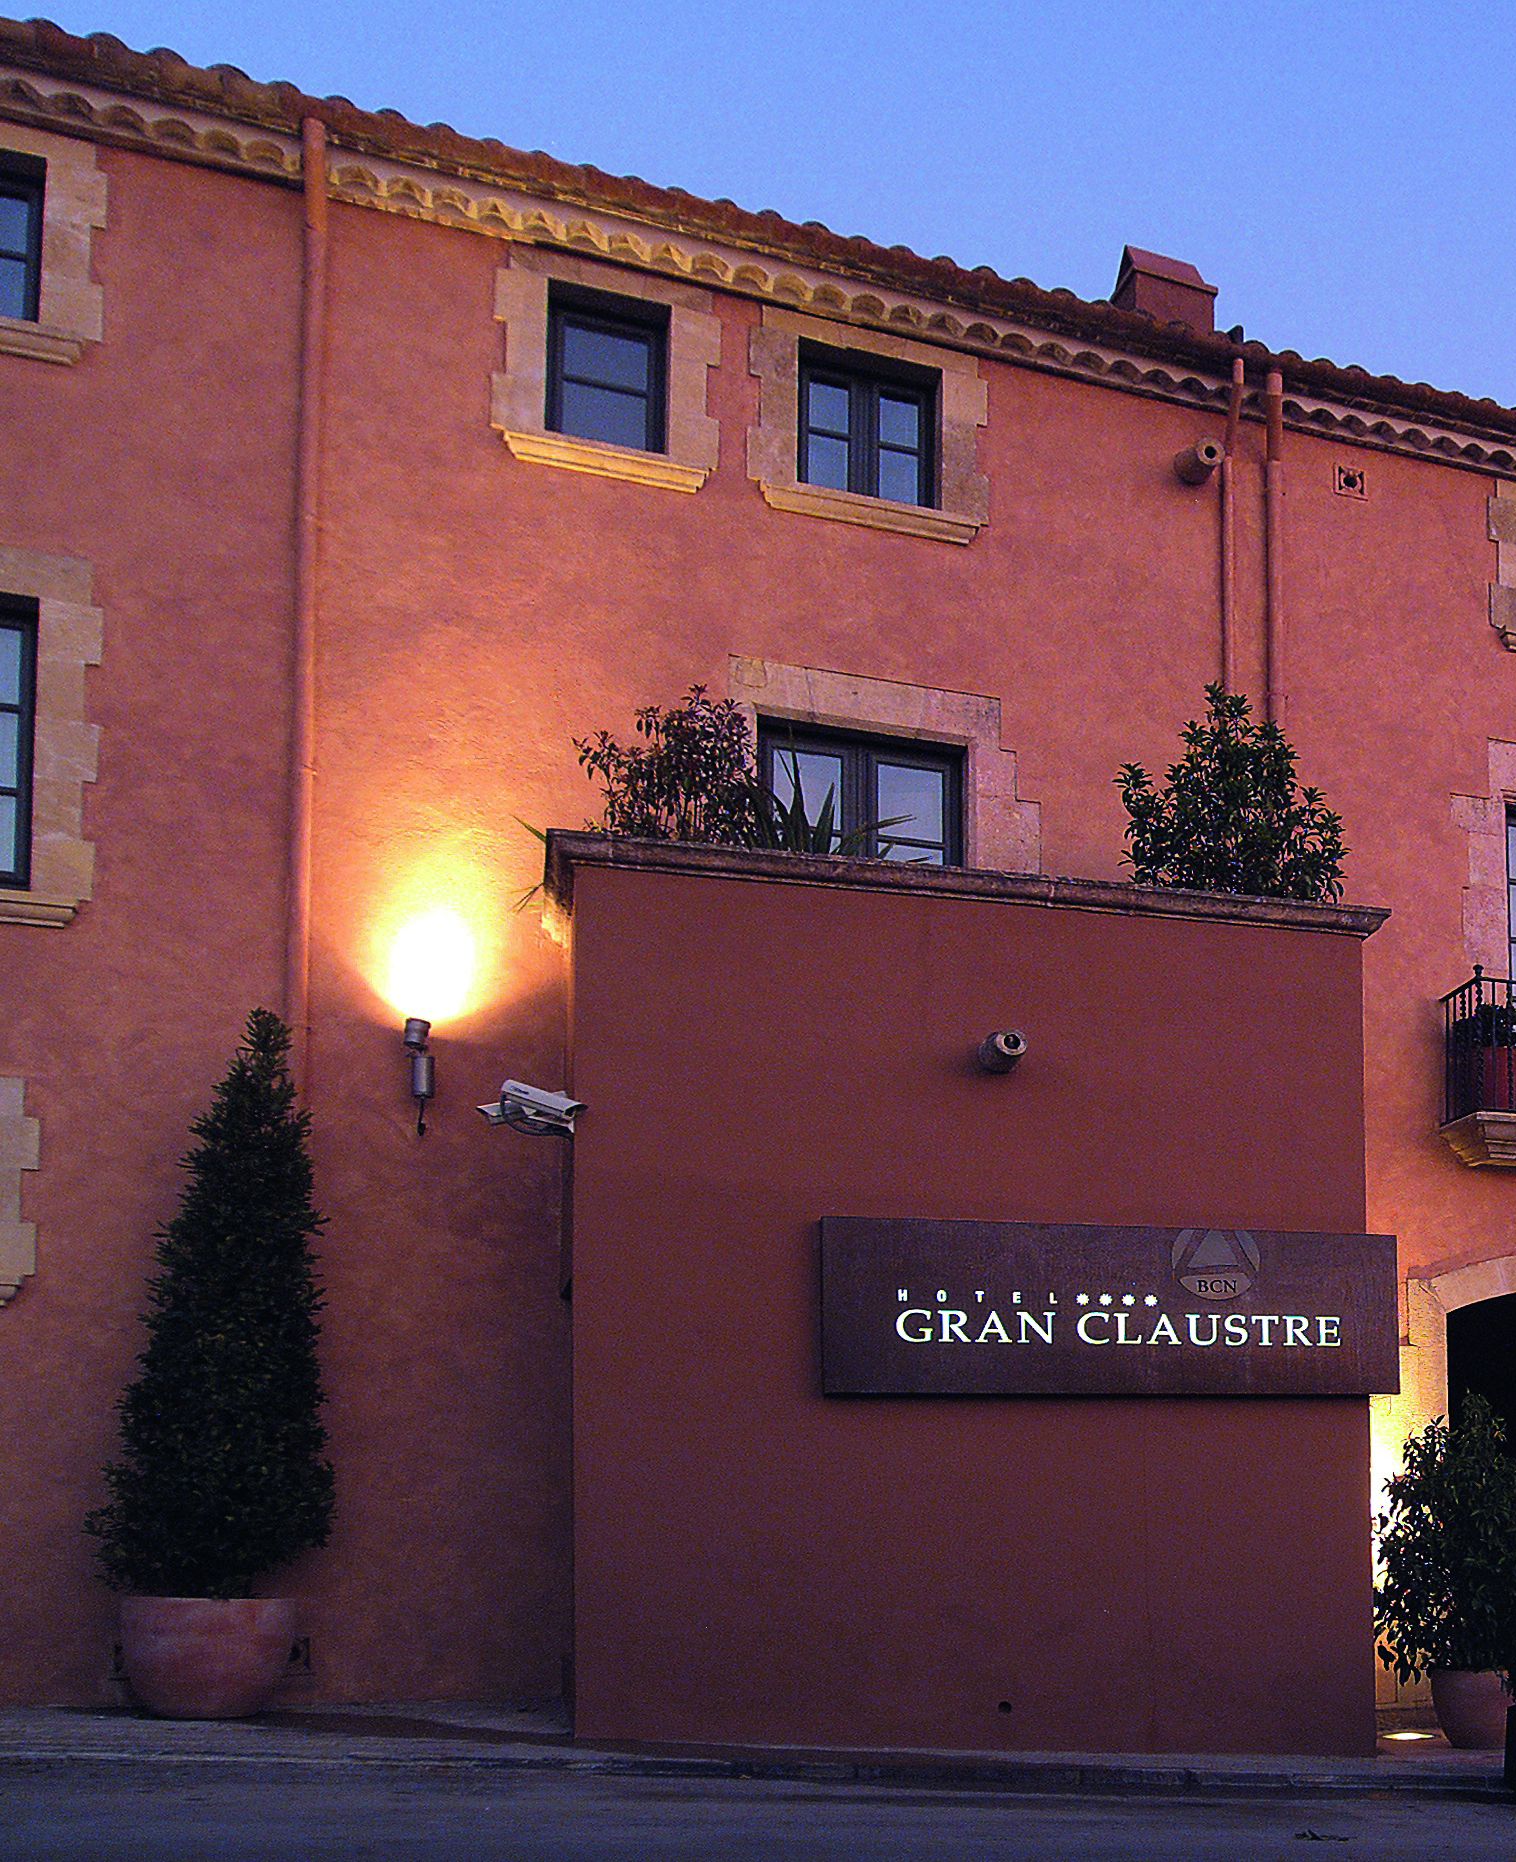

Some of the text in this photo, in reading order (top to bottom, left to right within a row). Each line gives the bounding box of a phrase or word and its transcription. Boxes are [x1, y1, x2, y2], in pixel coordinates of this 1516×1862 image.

[1197, 1279, 1237, 1293] BCN
[897, 1288, 1058, 1304] HOTEL
[895, 1308, 1341, 1347] GRAN CLAUSTRE
